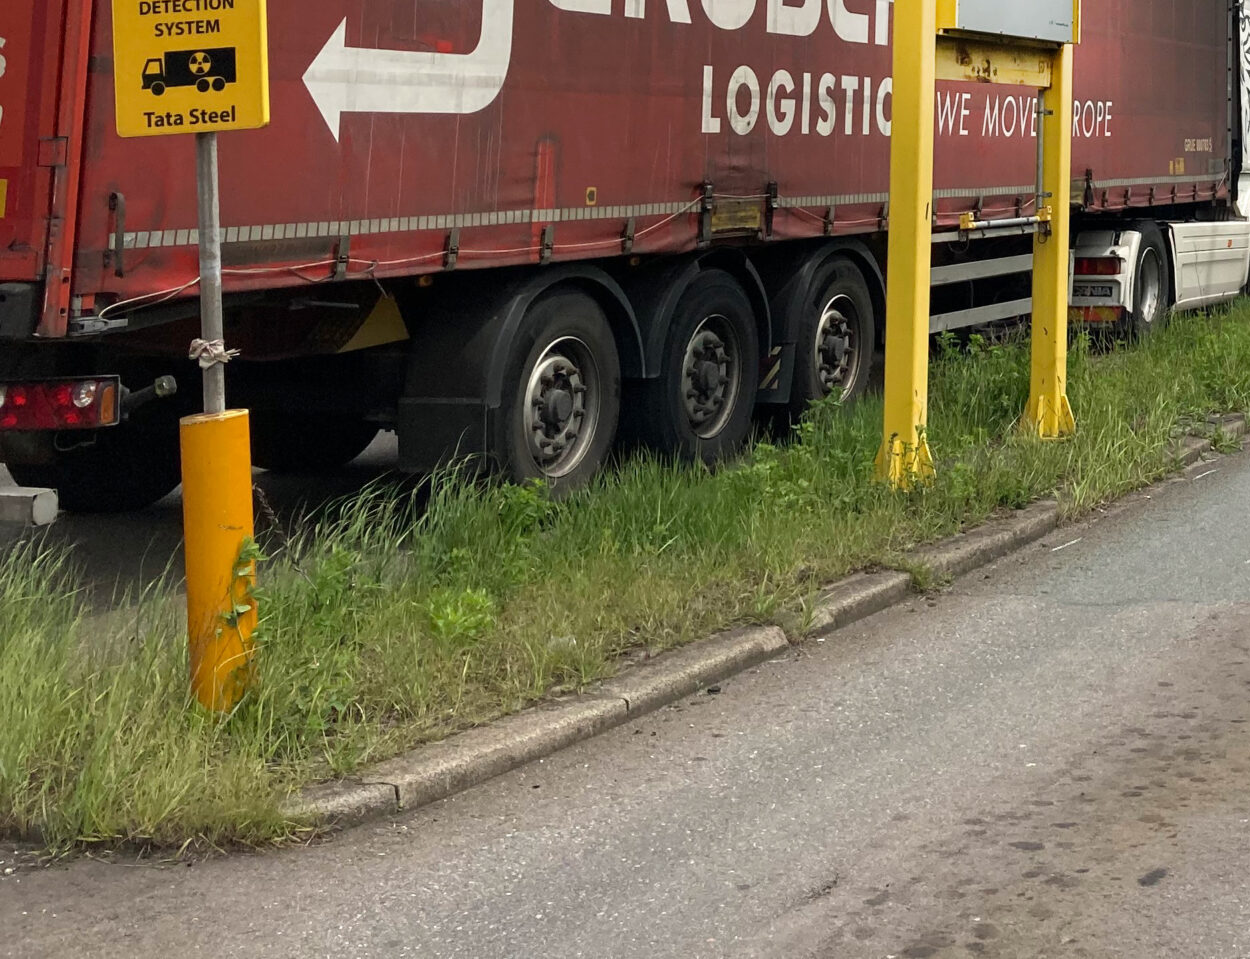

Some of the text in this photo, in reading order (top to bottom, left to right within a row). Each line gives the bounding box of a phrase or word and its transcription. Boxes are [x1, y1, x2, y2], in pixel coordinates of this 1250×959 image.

[154, 19, 221, 37] SYSTEM
[143, 105, 236, 128] Tata Steel
[701, 65, 893, 137] LOGISTIC
[936, 90, 1113, 138] WE MOVE ROPE
